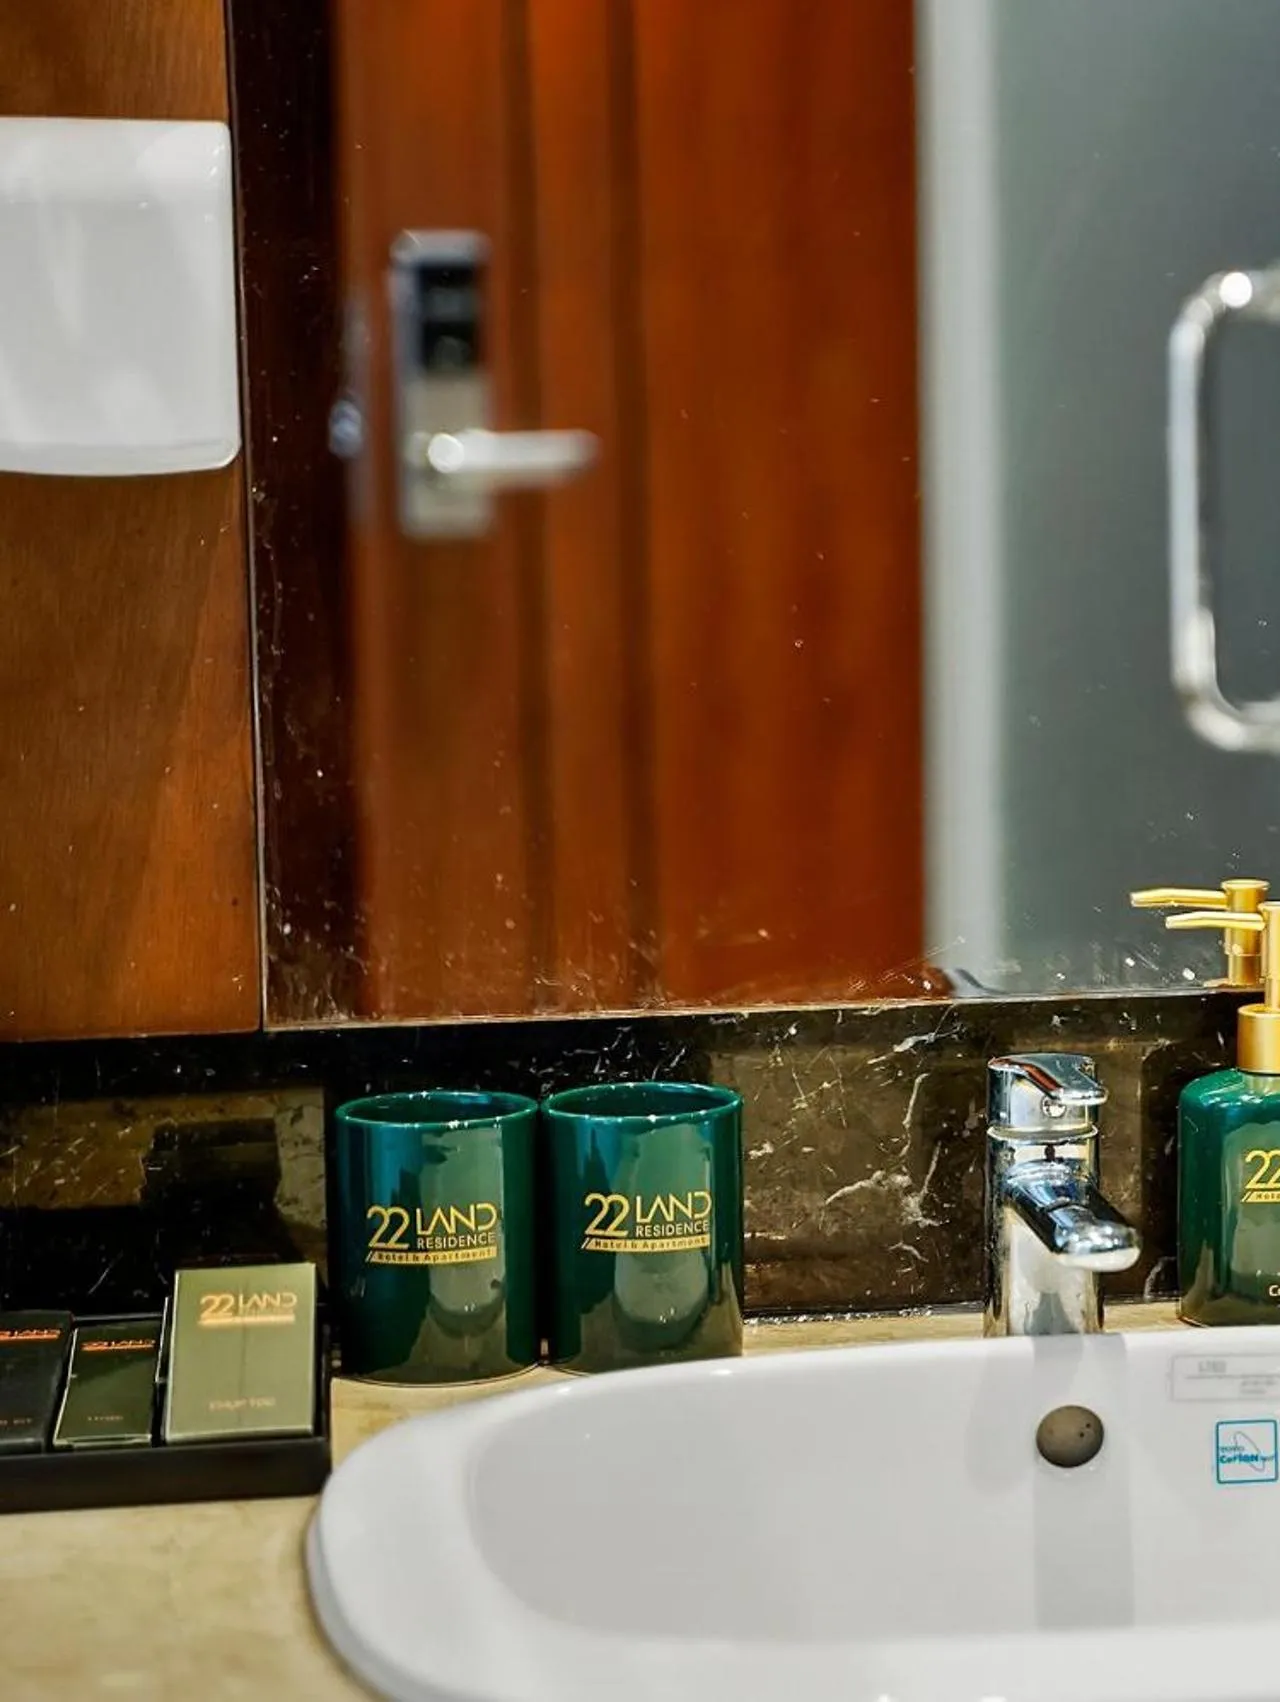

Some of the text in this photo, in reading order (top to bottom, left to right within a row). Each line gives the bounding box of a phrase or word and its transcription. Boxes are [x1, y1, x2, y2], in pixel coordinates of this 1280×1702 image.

[367, 1202, 498, 1249] 22 LAND
[584, 1191, 712, 1236] 22 LAND
[416, 1231, 497, 1250] RESIDENCE
[635, 1220, 710, 1237] RESIDENCE
[199, 1293, 235, 1319] 22
[238, 1292, 298, 1309] LAND
